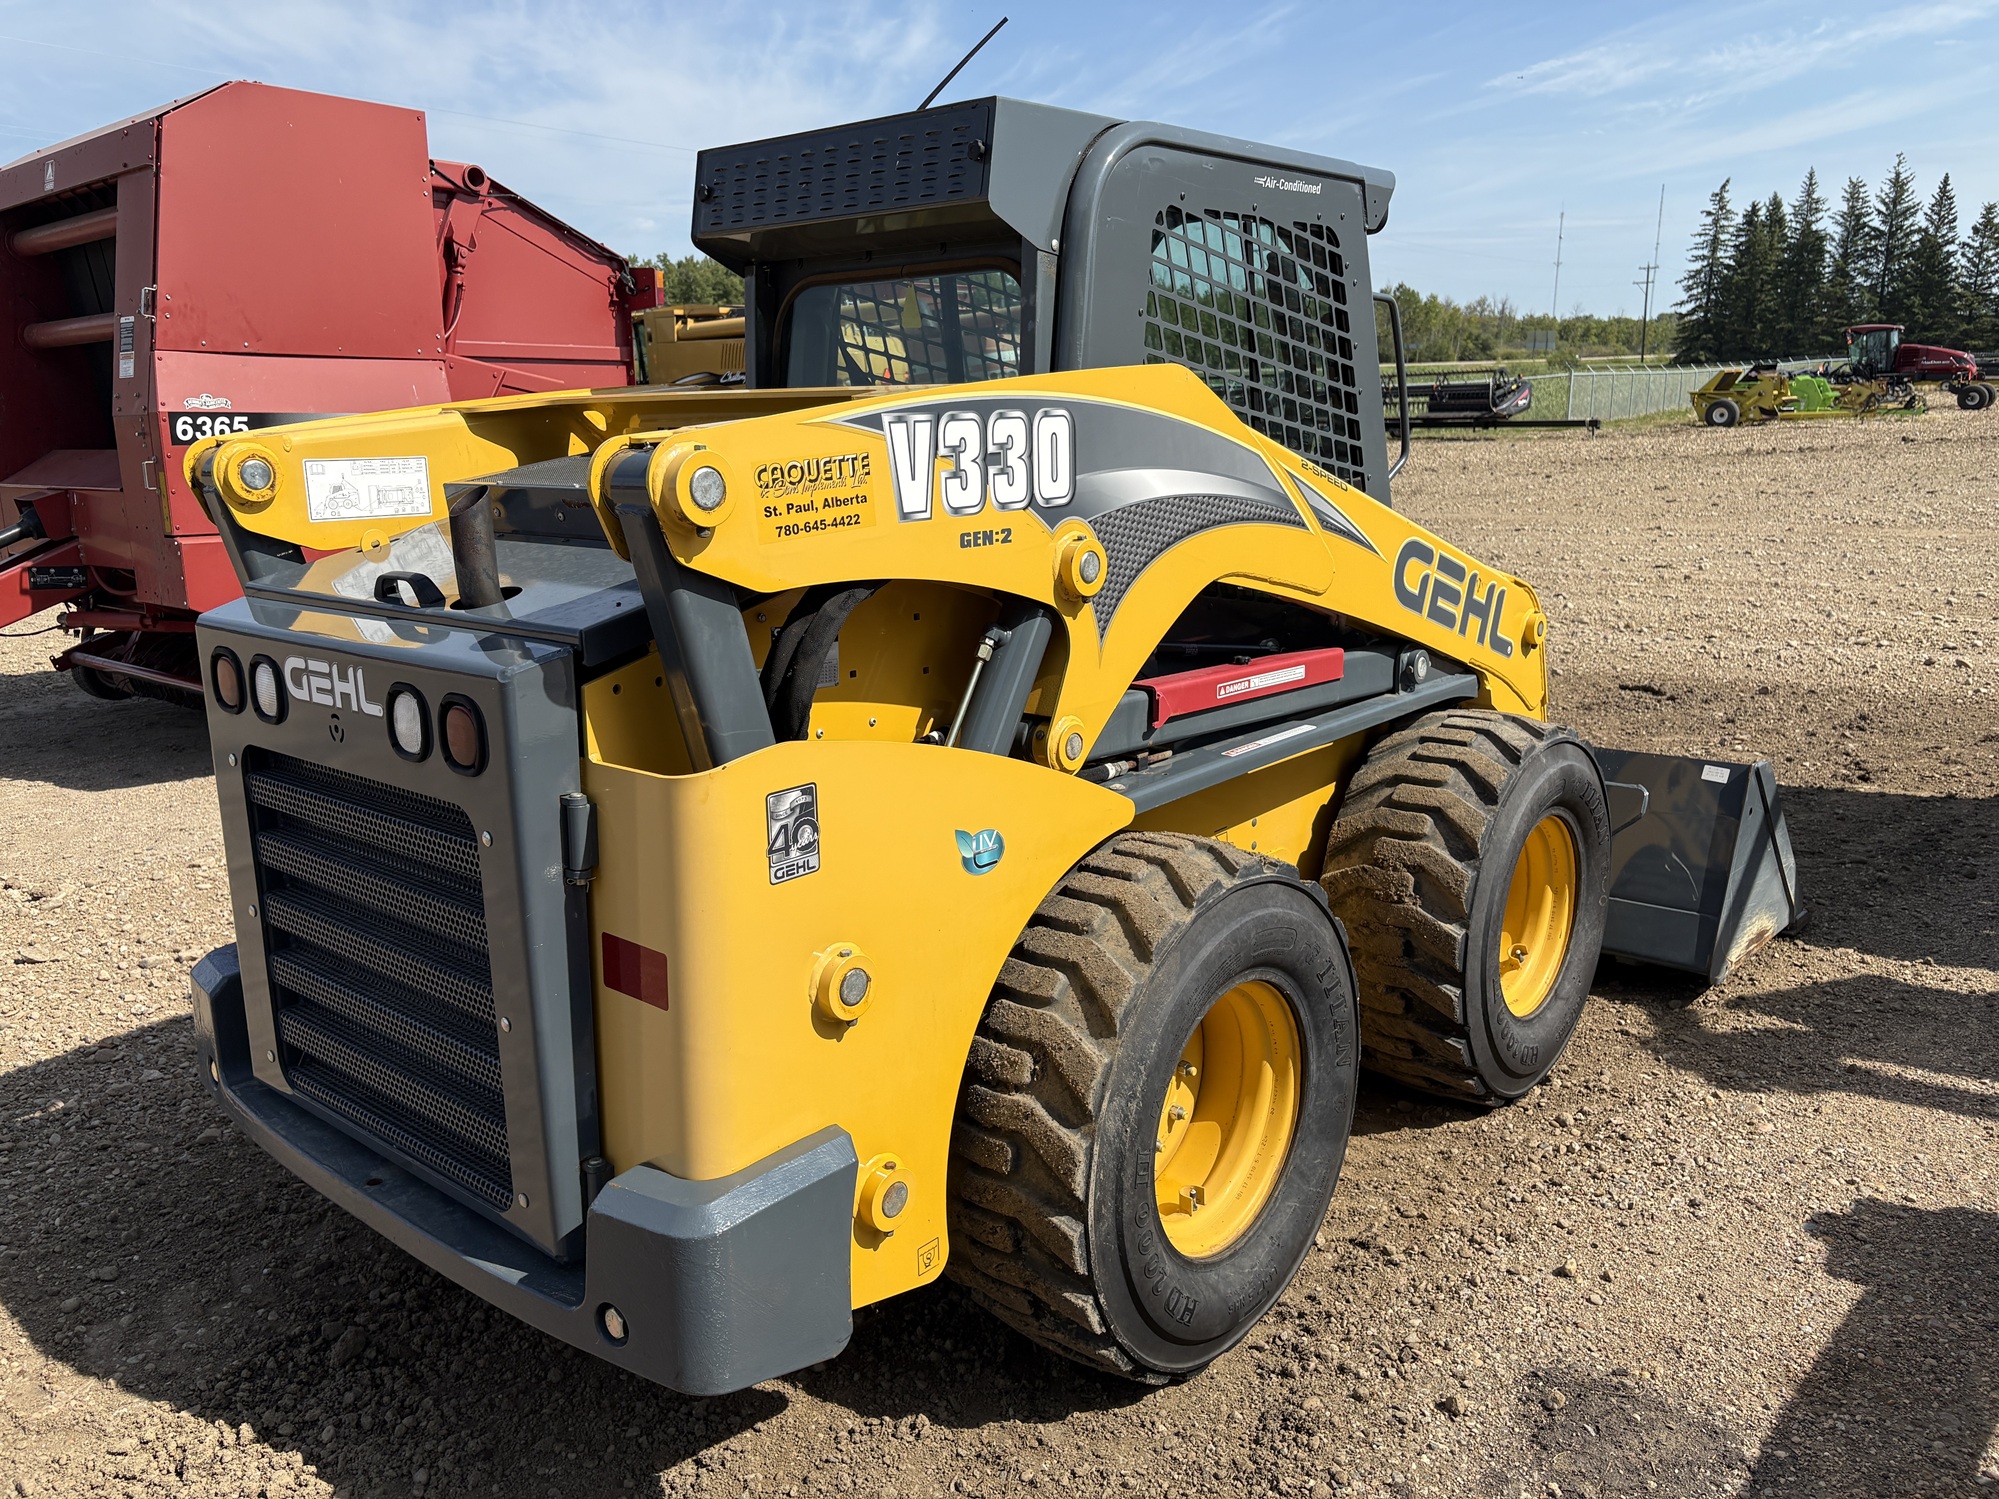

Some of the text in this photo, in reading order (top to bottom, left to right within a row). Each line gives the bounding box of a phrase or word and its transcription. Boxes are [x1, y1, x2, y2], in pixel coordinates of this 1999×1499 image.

[1264, 176, 1322, 195] Air-Conditioned
[175, 415, 250, 441] 6365
[881, 407, 1077, 524] V330
[1300, 458, 1348, 493] 2-SPEED
[763, 494, 868, 518] St. Paul, Alberta
[775, 513, 861, 538] 780-645-4422
[959, 527, 1012, 549] GEN:2
[1392, 536, 1514, 659] GEHL
[284, 655, 384, 717] GEHL
[1225, 681, 1249, 694] DANGER
[1579, 780, 1610, 846] TITAN
[773, 858, 817, 880] GEHL
[1316, 957, 1352, 1068] TITAN
